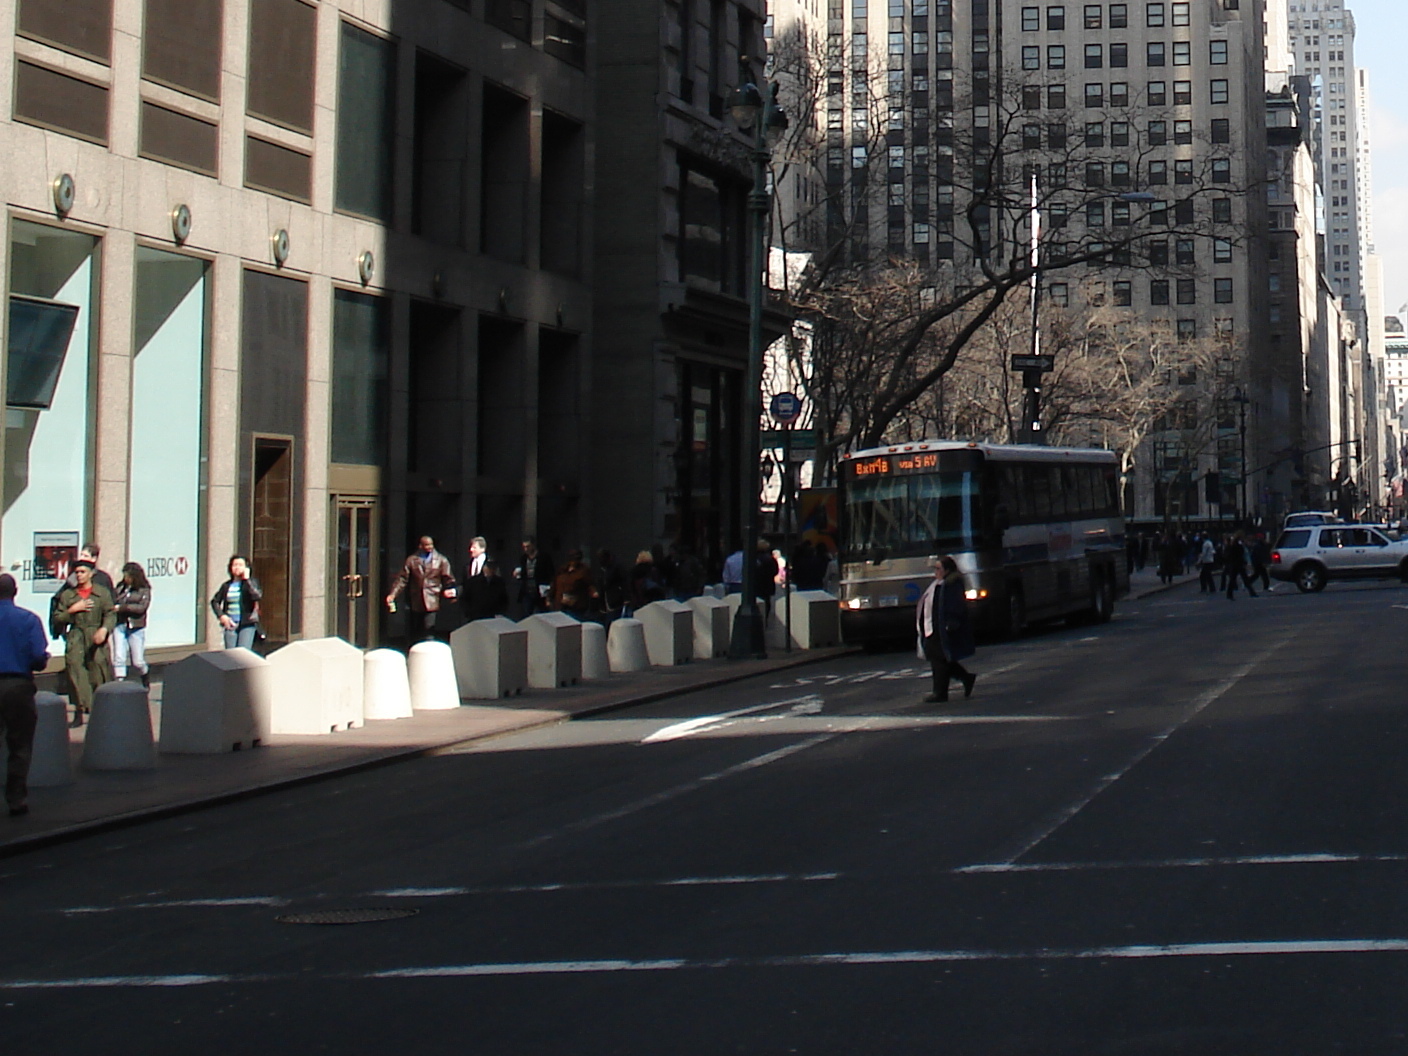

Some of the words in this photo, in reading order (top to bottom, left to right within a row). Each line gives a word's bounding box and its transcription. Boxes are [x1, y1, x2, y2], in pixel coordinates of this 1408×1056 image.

[915, 455, 922, 468] 5
[923, 454, 937, 467] AV
[147, 558, 173, 577] HSBC
